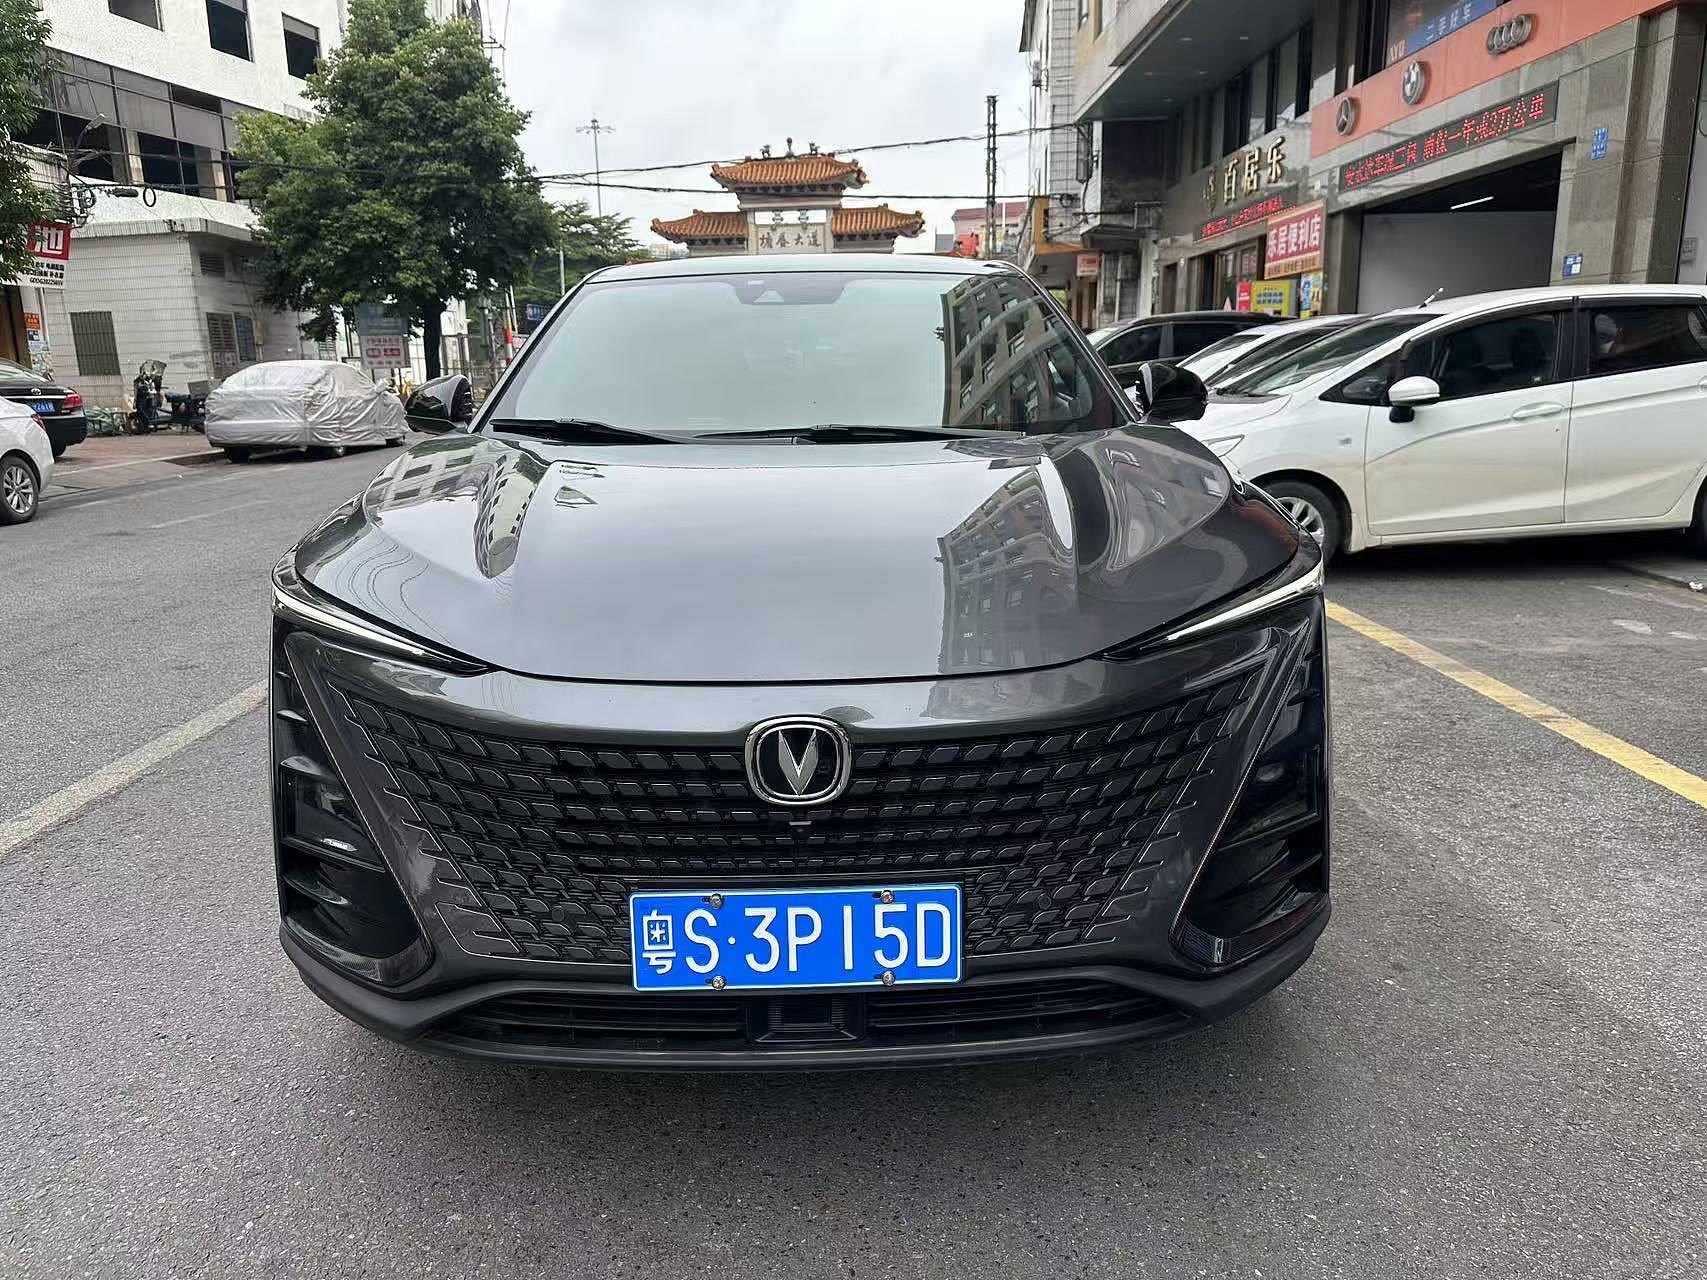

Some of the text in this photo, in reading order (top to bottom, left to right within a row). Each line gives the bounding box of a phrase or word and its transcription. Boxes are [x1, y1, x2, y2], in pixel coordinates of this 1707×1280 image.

[1223, 136, 1285, 205] 百居乐
[642, 902, 951, 975] 粤S·3P15D
